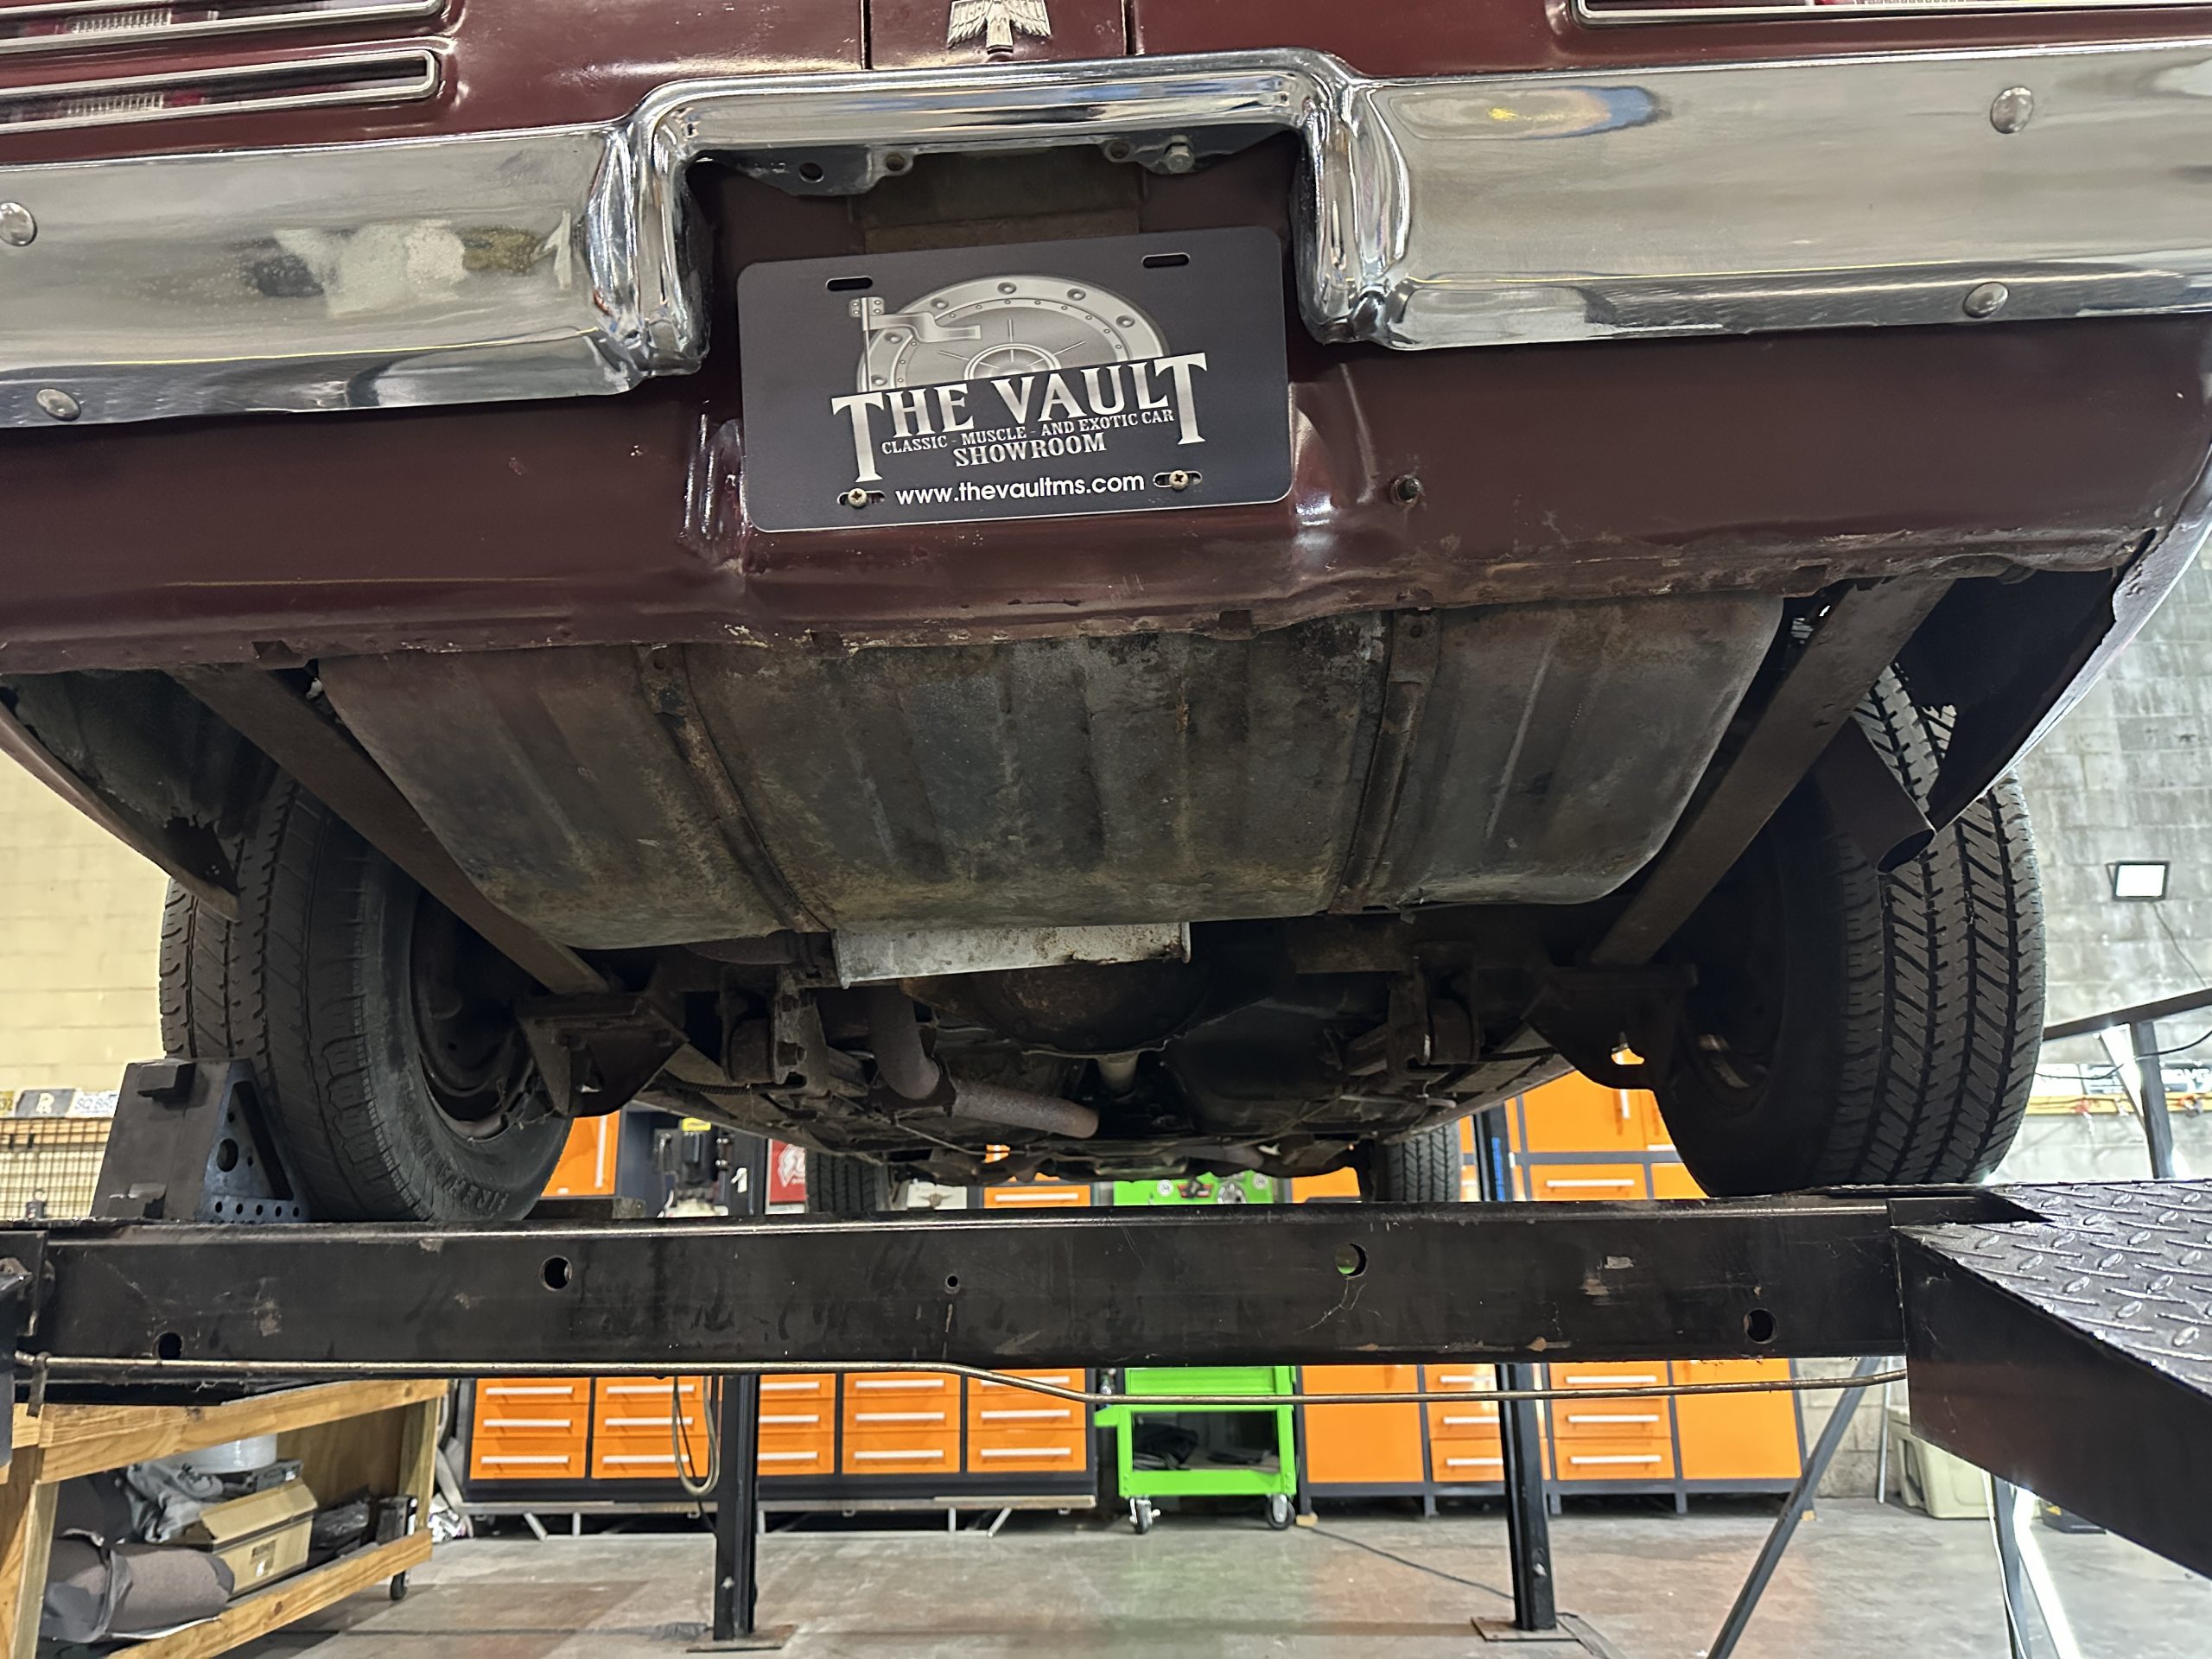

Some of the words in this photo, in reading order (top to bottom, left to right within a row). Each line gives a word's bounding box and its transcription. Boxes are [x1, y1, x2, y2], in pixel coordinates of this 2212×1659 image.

[831, 380, 975, 483] THE
[990, 353, 1208, 445] VAULT
[881, 435, 948, 454] CLASSIC
[961, 426, 1027, 446] MUSCLE
[1040, 421, 1075, 436] AND
[1078, 413, 1139, 433] EXOTIC
[1141, 409, 1175, 424] CAR
[952, 432, 1107, 467] SHOWROOM
[895, 475, 1145, 505] www.thevaultms.com
